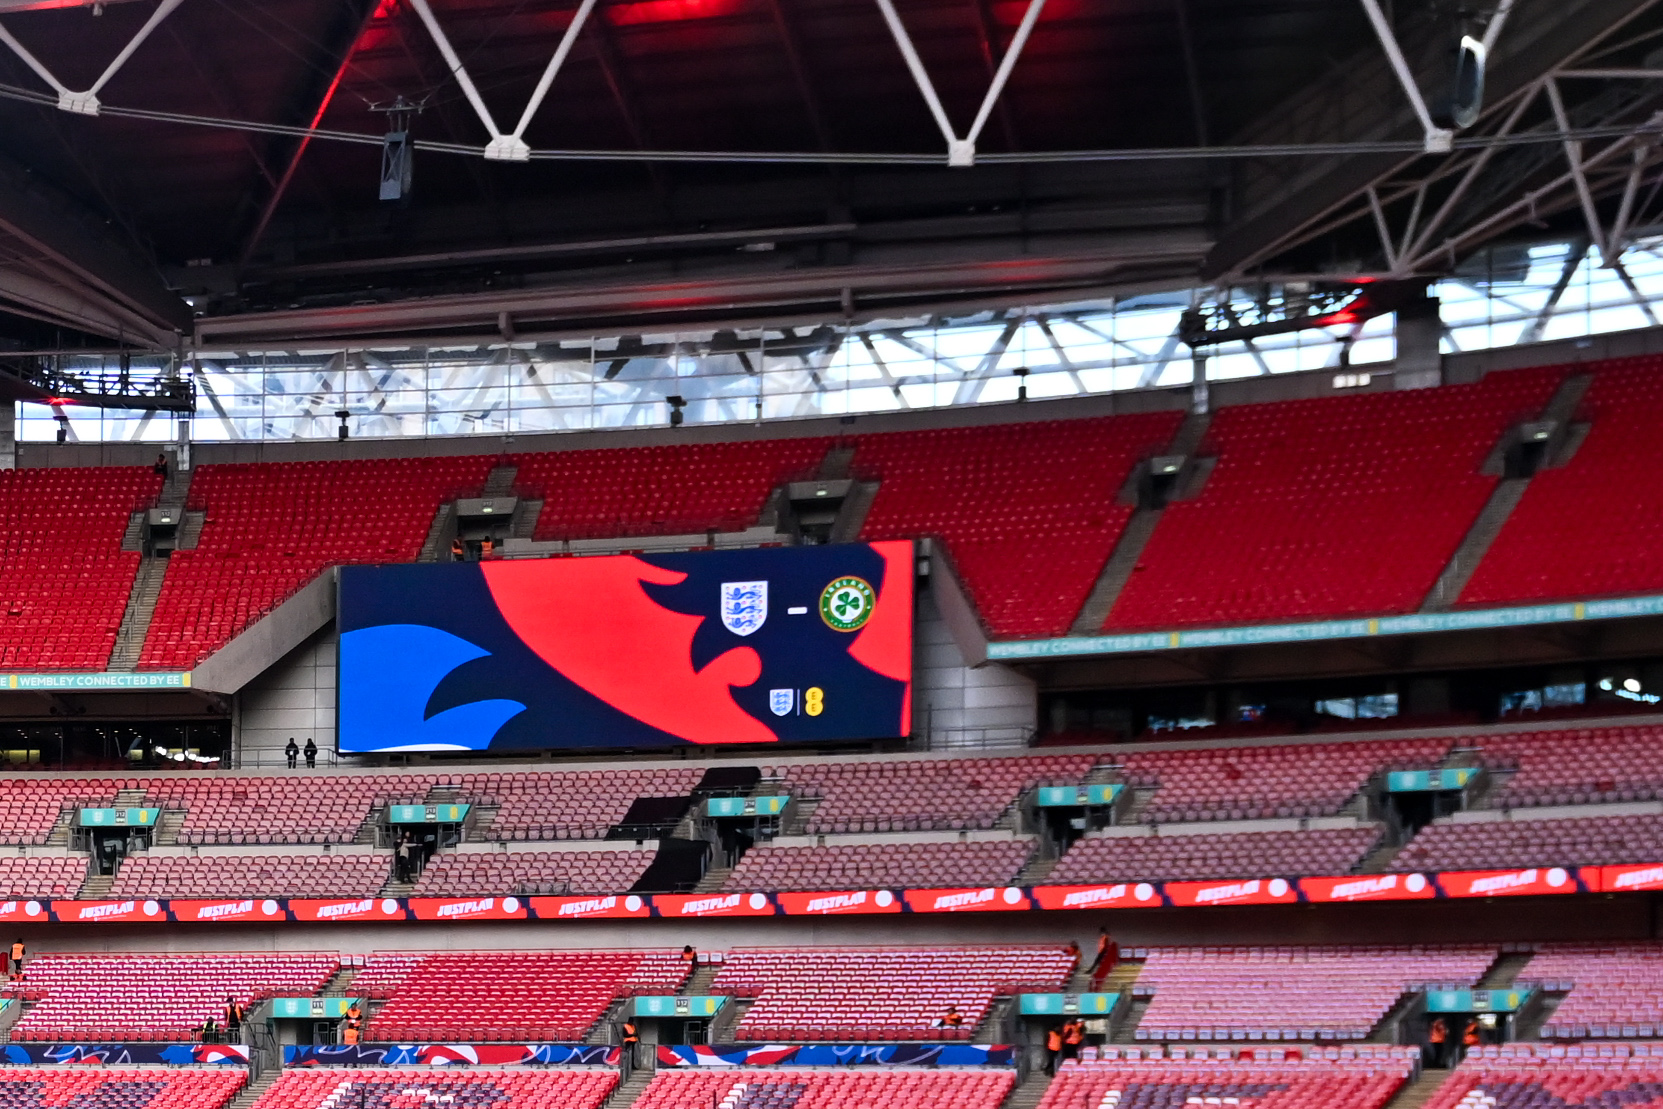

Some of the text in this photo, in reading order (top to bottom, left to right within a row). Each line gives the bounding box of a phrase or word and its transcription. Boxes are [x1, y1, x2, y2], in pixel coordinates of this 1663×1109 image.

[20, 675, 180, 686] WEMBLEY CONNECTED BY EE
[79, 901, 134, 919] JUSTPLAY
[198, 900, 253, 919] JUSTPLAY
[317, 899, 373, 918] JUSTPLAY
[437, 898, 494, 918] JUSTPLAY
[558, 896, 616, 916] JUSTPLAY
[682, 894, 740, 915] JUSTPLAY
[807, 891, 867, 912] JUSTPLAY
